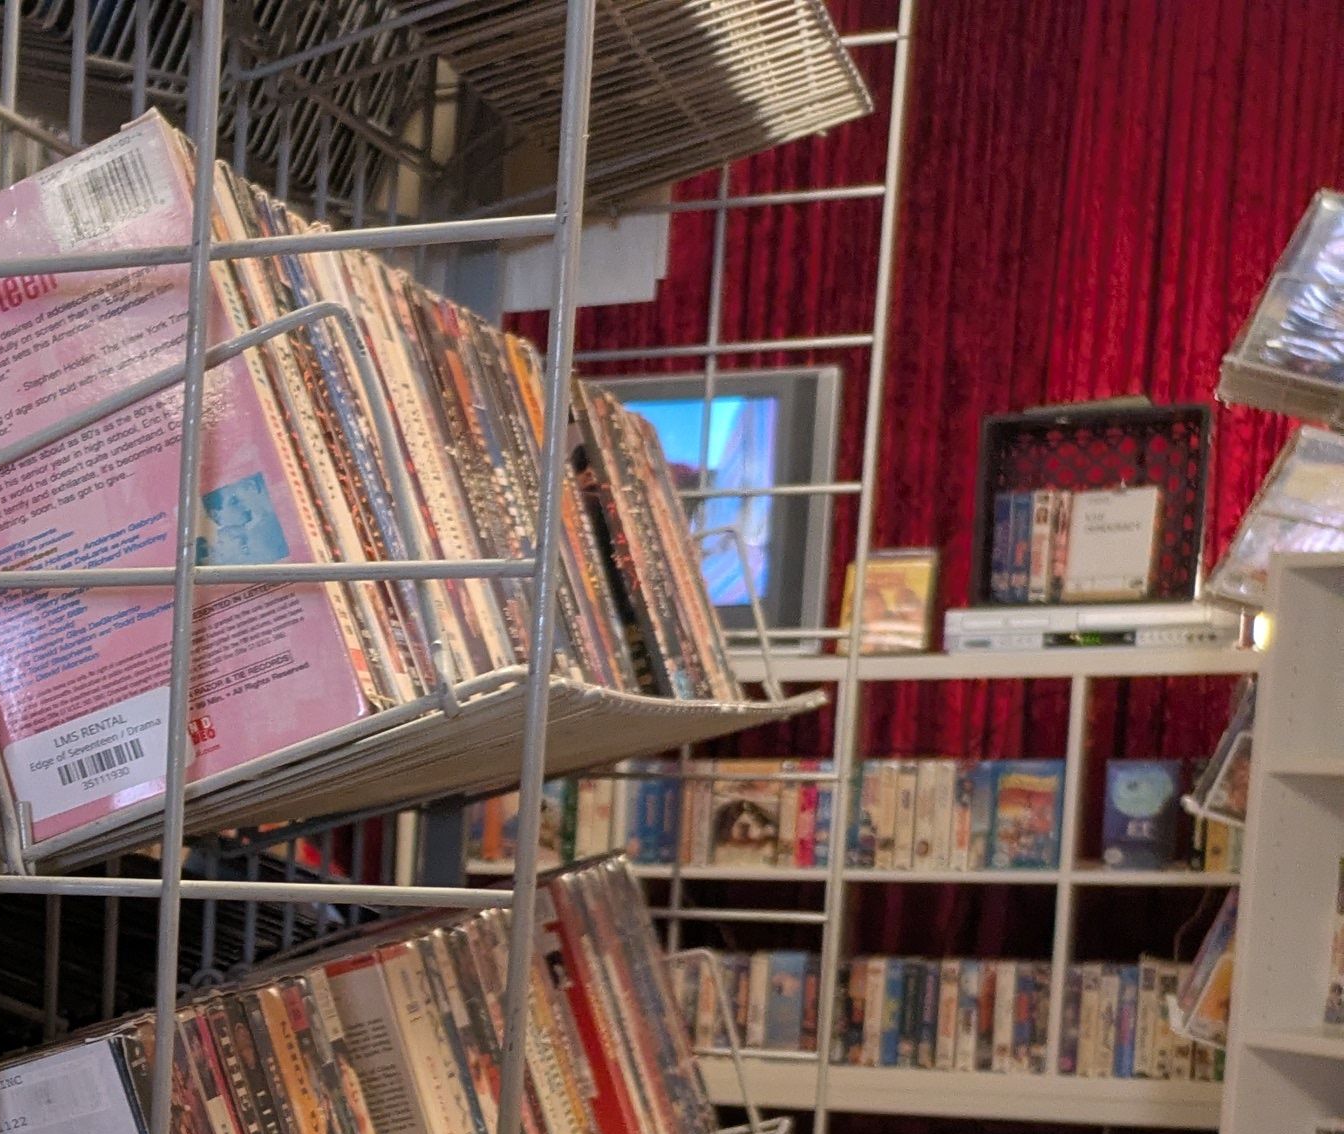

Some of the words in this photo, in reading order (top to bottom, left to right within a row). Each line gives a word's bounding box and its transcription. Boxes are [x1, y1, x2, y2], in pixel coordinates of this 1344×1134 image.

[0, 319, 33, 343] desires
[23, 369, 62, 392] Stephen
[249, 654, 290, 678] RECORDS
[270, 661, 311, 687] Reserved
[53, 729, 81, 749] LMS
[80, 713, 129, 739] RENTAL
[29, 754, 54, 773] Edge
[65, 733, 118, 762] Seventeen
[127, 716, 162, 740] Drama
[80, 765, 131, 792] 35111930
[0, 1075, 23, 1090] INC
